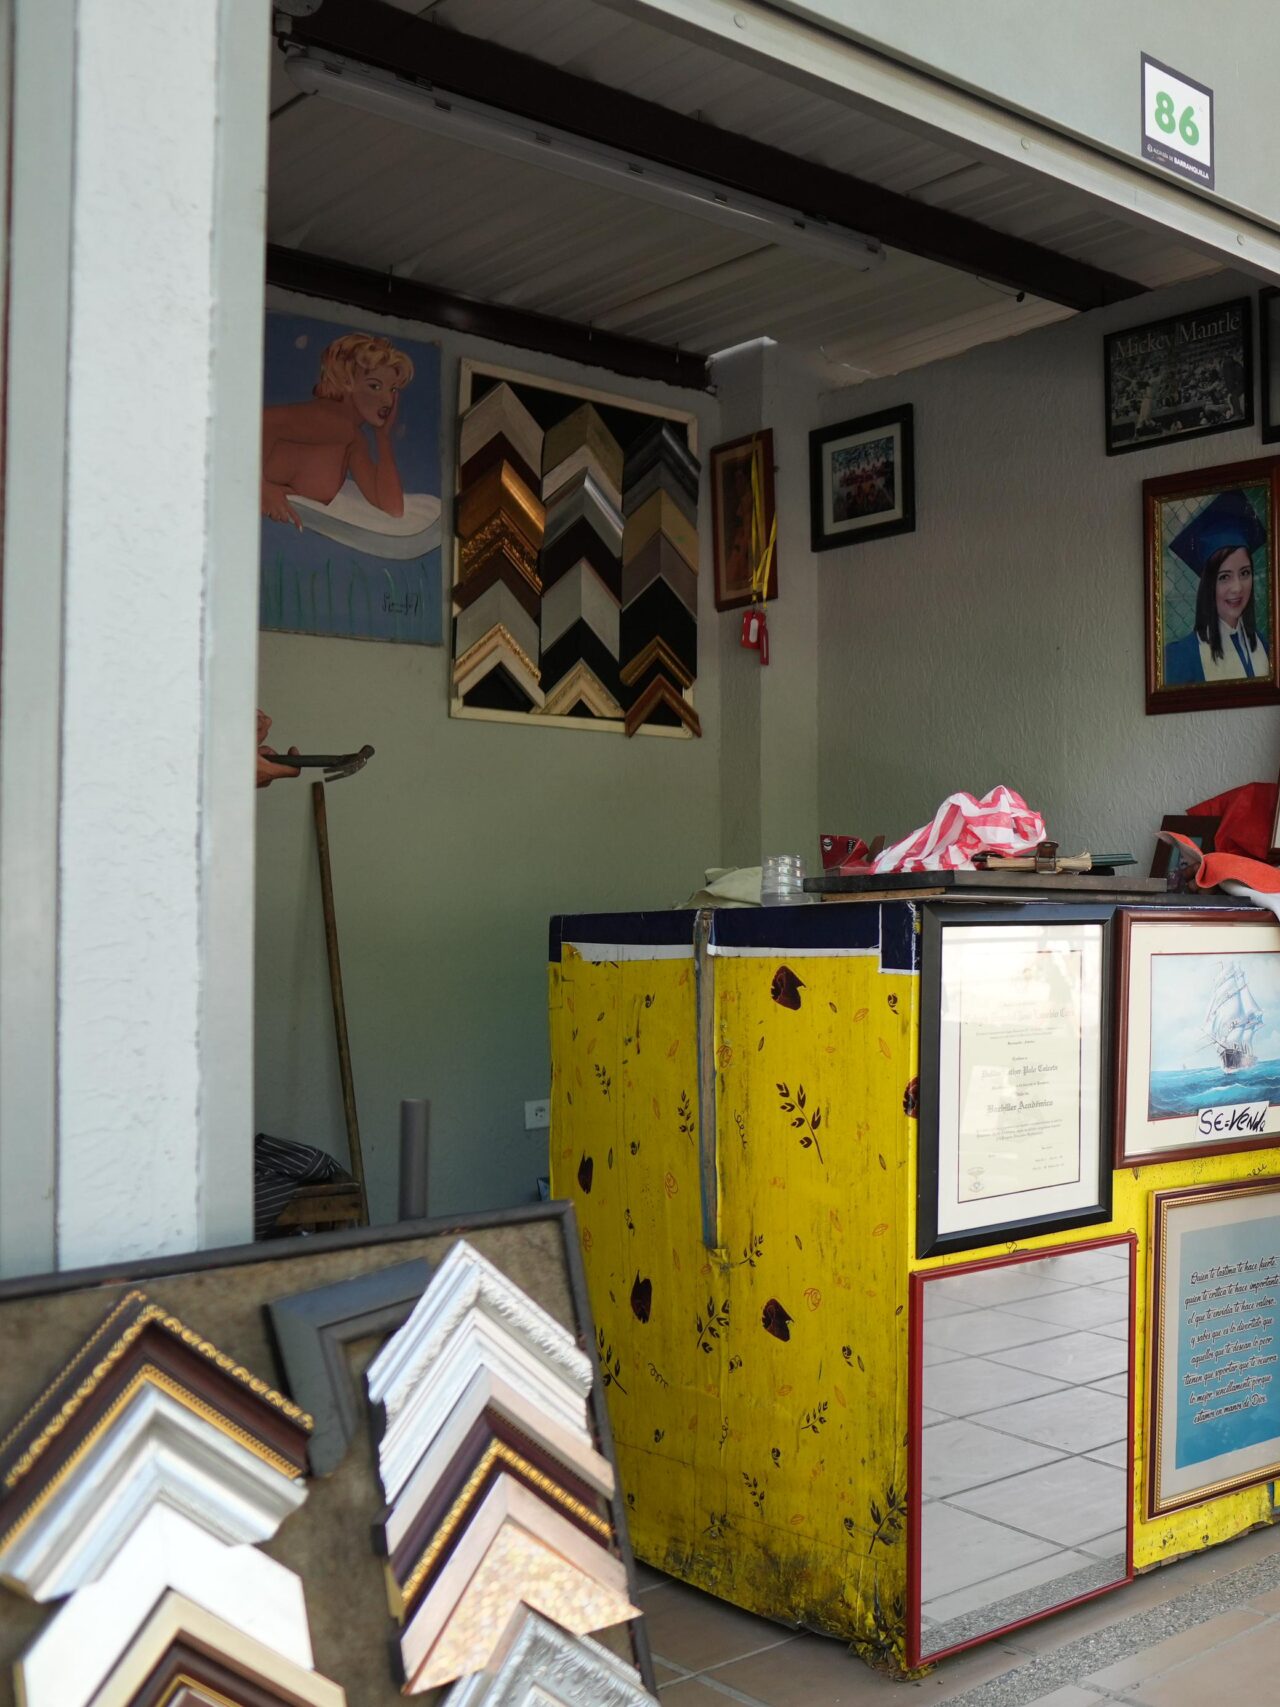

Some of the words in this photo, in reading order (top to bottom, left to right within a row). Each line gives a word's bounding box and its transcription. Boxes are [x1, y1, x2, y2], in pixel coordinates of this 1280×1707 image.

[1154, 91, 1200, 146] 86
[1174, 156, 1210, 180] BARRANQUILLA
[1115, 333, 1172, 361] Mickey
[1177, 312, 1240, 344] Mantle
[1190, 1271, 1208, 1284] Quien
[1217, 1265, 1237, 1277] lastima
[1244, 1260, 1258, 1271] hace
[1184, 1294, 1201, 1310] quien
[1234, 1282, 1248, 1293] hace
[1188, 1312, 1195, 1324] el
[1195, 1316, 1205, 1328] que
[1205, 1308, 1213, 1319] te
[1213, 1304, 1233, 1317] envidia
[1241, 1300, 1254, 1311] hace
[1190, 1336, 1196, 1347] y
[1197, 1330, 1211, 1342] sabes
[1212, 1331, 1221, 1343] que
[1229, 1322, 1236, 1332] lo
[1236, 1316, 1262, 1331] divertido
[1263, 1318, 1273, 1330] que
[1190, 1348, 1214, 1368] aquellos
[1215, 1349, 1224, 1362] que
[1232, 1341, 1252, 1352] desean
[1252, 1337, 1258, 1347] lo
[1258, 1337, 1273, 1351] peor
[1184, 1374, 1202, 1386] tienen
[1203, 1372, 1213, 1386] que
[1239, 1362, 1250, 1375] que
[1249, 1356, 1257, 1367] te
[1257, 1355, 1278, 1365] ocurra
[1189, 1392, 1196, 1404] lo
[1215, 1375, 1251, 1397] sencillamente
[1251, 1375, 1272, 1391] porque
[1193, 1409, 1215, 1424] estamos
[1215, 1408, 1222, 1417] en
[1223, 1401, 1242, 1413] manos
[1242, 1396, 1250, 1407] de
